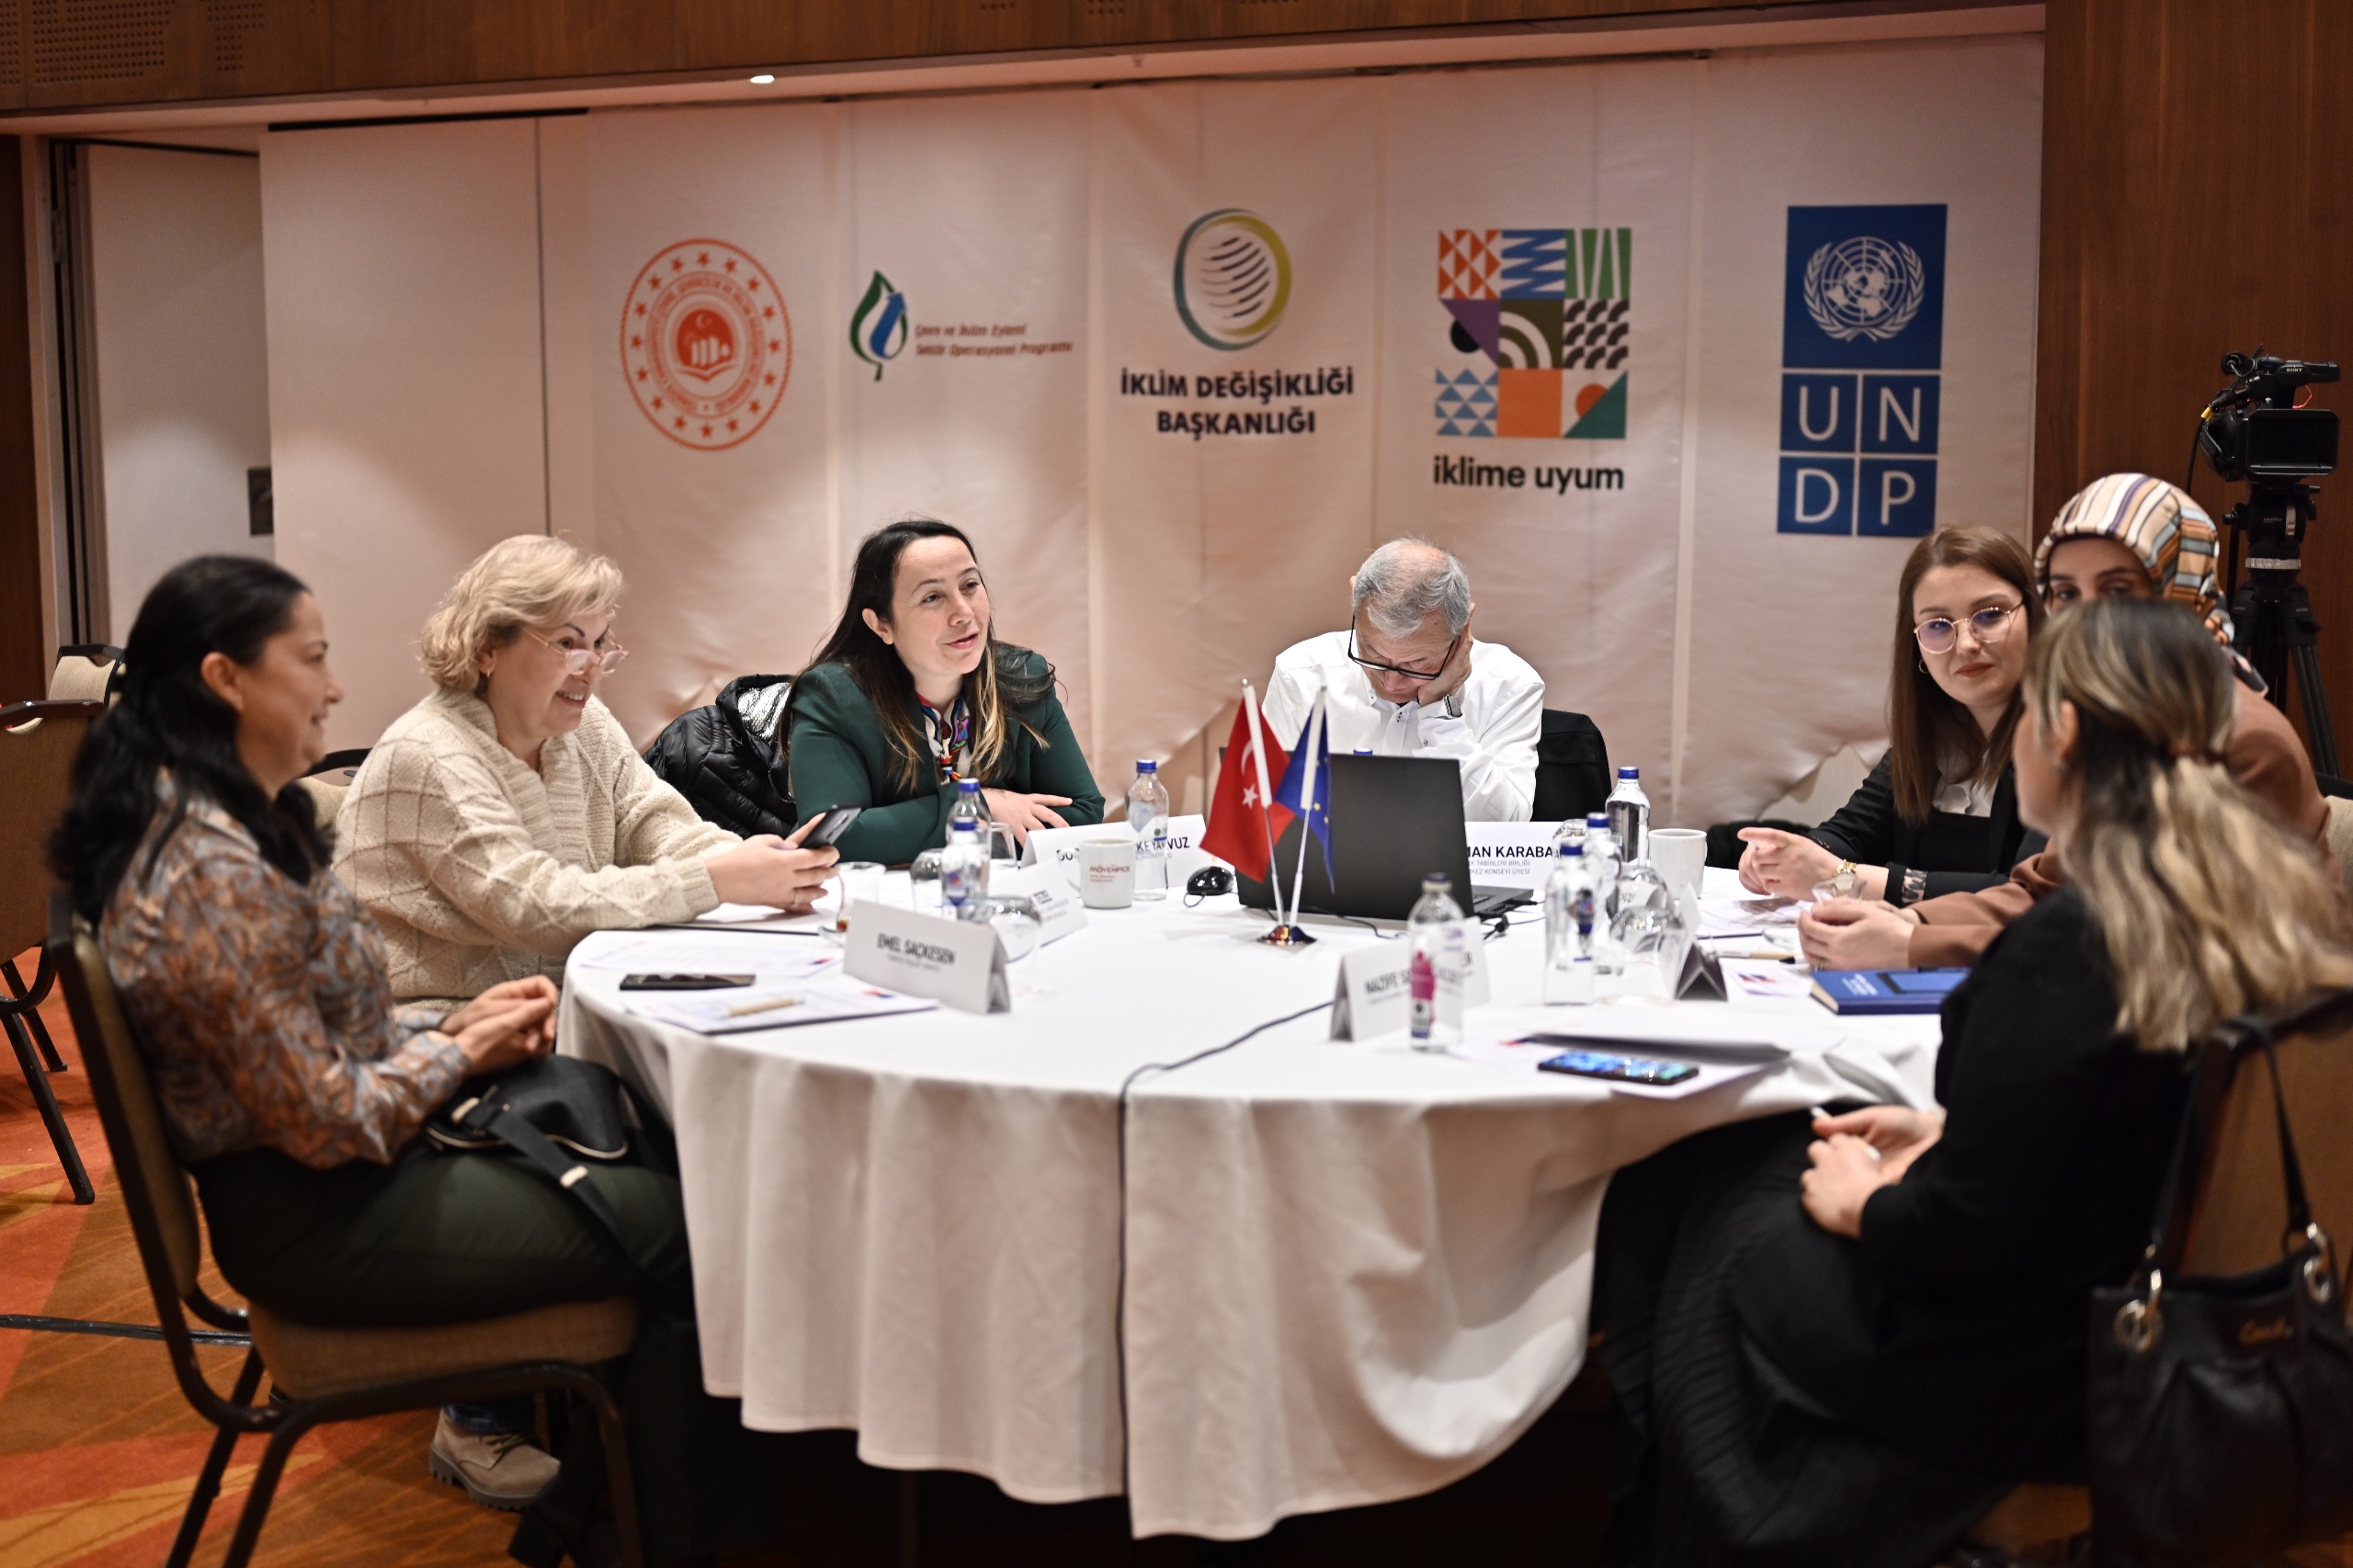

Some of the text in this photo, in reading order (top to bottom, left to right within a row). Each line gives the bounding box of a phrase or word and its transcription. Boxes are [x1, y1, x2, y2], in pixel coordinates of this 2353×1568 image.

[1120, 366, 1353, 404] İKLİM DEĞİŞİKLİĞİ
[1157, 406, 1315, 440] BAŞKANLIĞI
[1434, 456, 1624, 495] iklime uyum
[1508, 858, 1530, 867] BİRLİĞİ
